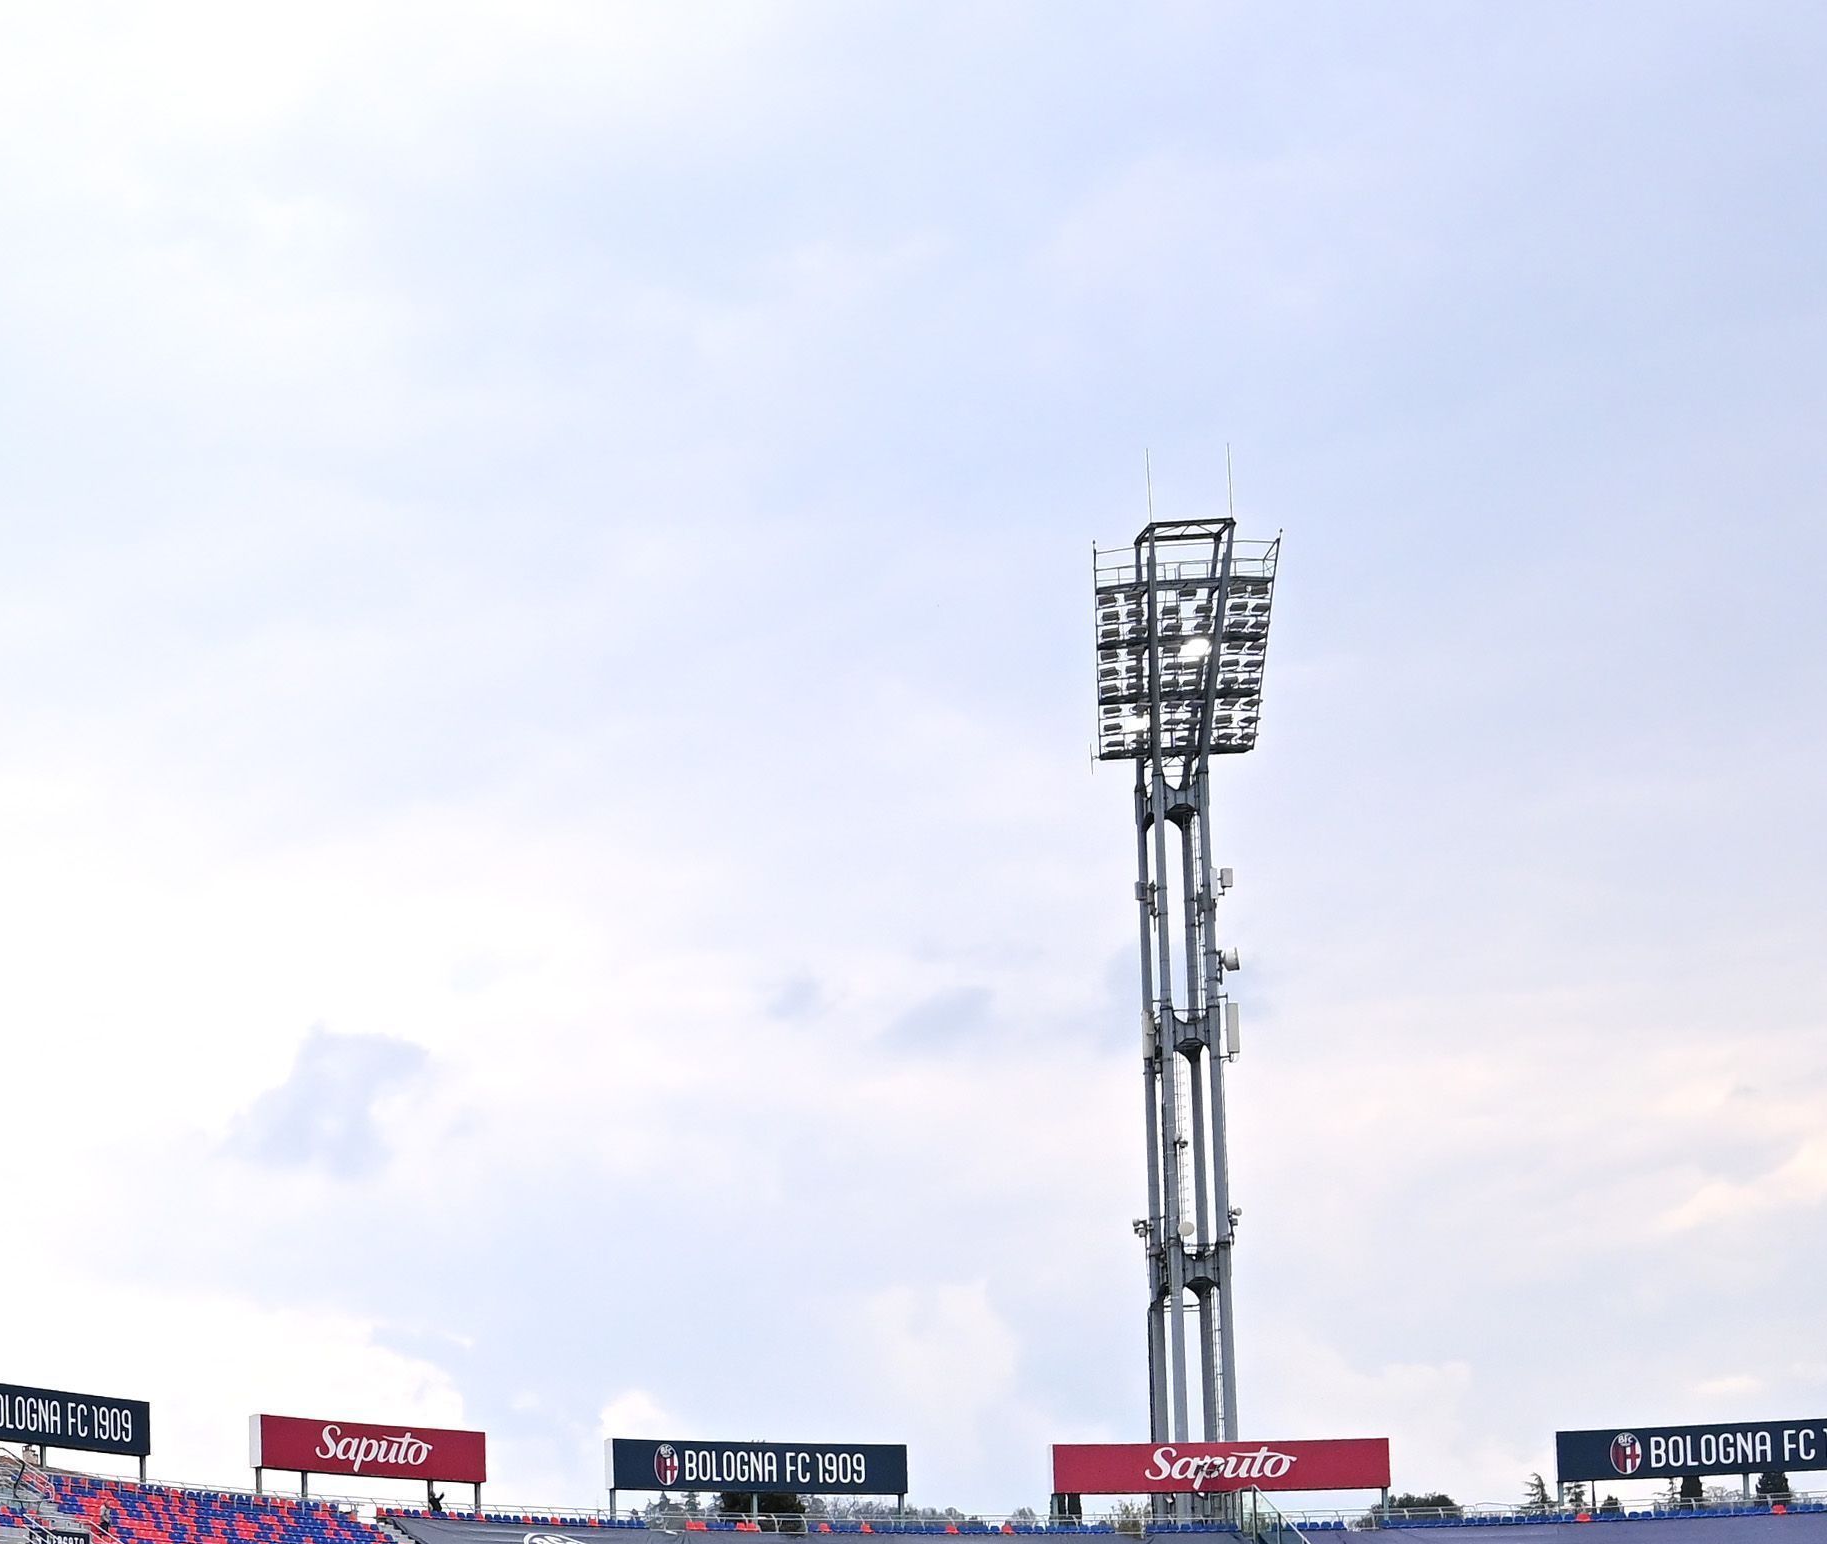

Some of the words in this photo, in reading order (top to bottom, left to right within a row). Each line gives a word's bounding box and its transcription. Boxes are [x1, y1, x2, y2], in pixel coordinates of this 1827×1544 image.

[68, 1403, 87, 1437] FC
[92, 1405, 132, 1442] 1909
[315, 1425, 433, 1472] Saputo
[684, 1450, 777, 1482] BOLOGNA
[786, 1452, 810, 1483] FC
[816, 1453, 865, 1483] 1909
[1145, 1446, 1297, 1490] Saputo
[1650, 1431, 1772, 1468] BOLOGNA
[1783, 1429, 1815, 1461] FC
